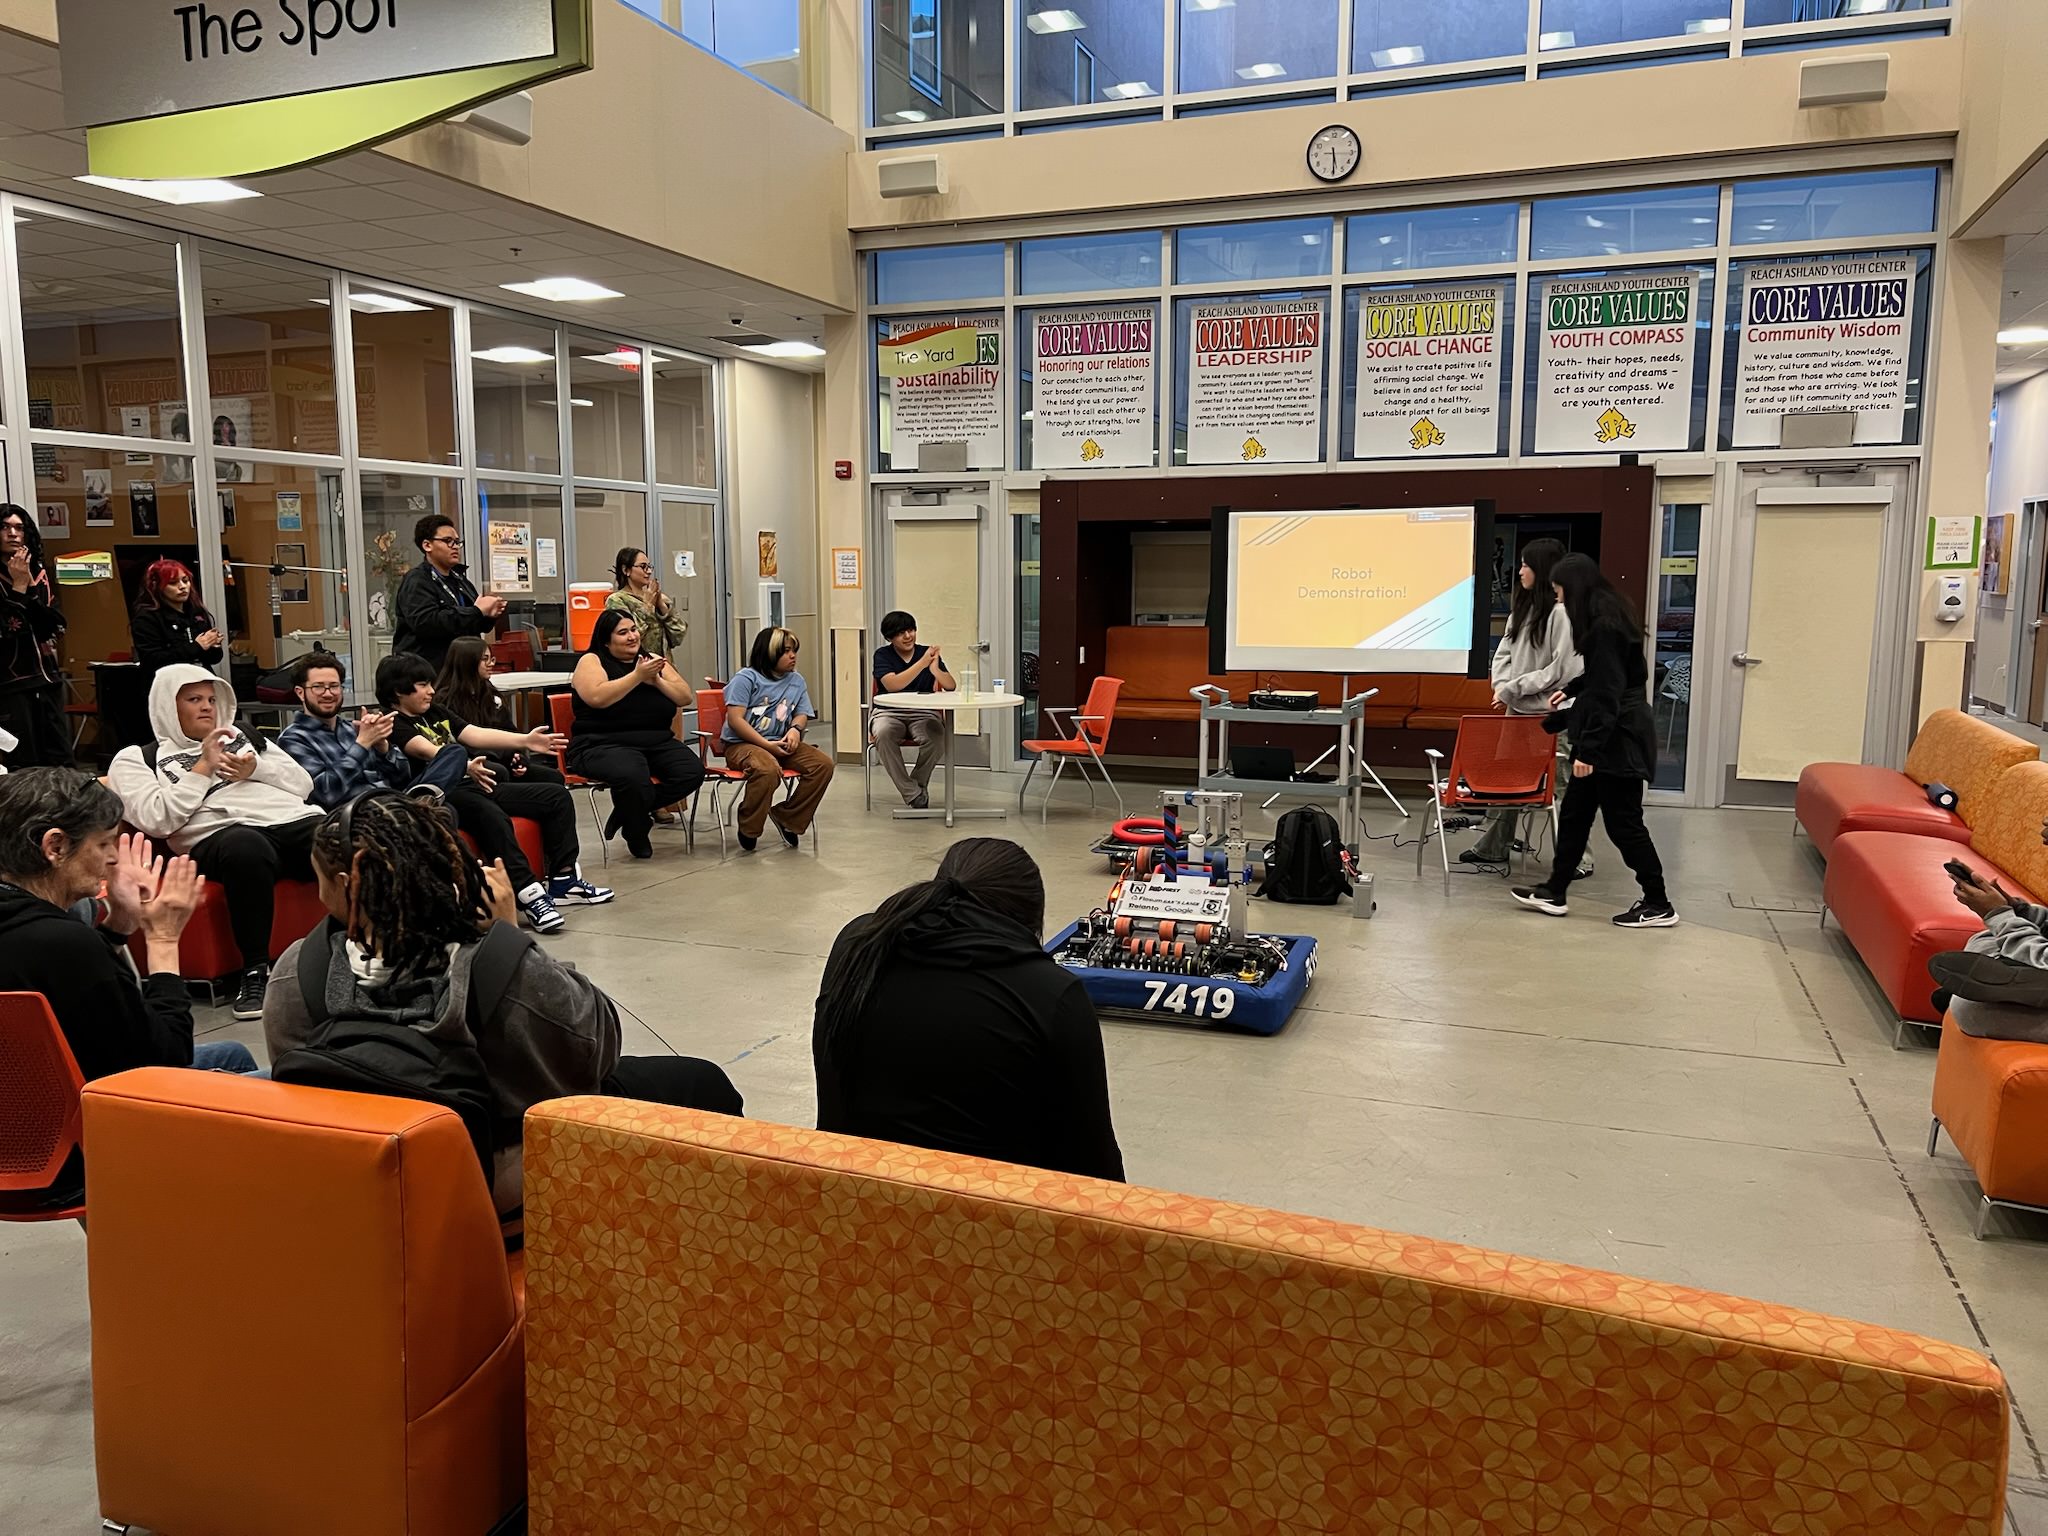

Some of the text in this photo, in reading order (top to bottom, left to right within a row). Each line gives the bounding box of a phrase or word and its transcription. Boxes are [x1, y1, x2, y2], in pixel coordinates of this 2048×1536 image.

[174, 3, 262, 61] The
[1751, 261, 1905, 280] REACH ASHLAND YOUTH CENTER
[1552, 277, 1689, 294] REACH ASHLAND YOUTH CENTER
[1368, 289, 1495, 304] REACH ASHLAND YOUTH CENTER
[1752, 281, 1902, 323] CORE VALUES
[1198, 303, 1317, 318] REACH ASHLAND YOUTH CENTER
[1550, 290, 1686, 327] CORE VALUES
[1039, 309, 1151, 324] REACH ASHLAND YOUTH CENTER
[1368, 302, 1493, 338] CORE VALUES
[1040, 321, 1148, 355] CORE VALUES
[1198, 315, 1314, 351] CORE VALUES
[1551, 328, 1684, 348] YOUTH COMPASS
[1748, 322, 1900, 342] Community Wisdom
[1367, 337, 1492, 358] SOCIAL CHANGE
[895, 351, 919, 364] The
[924, 348, 954, 362] Yard
[1198, 350, 1312, 367] LEADERSHIP
[1548, 353, 1684, 367] Youth- their hopes, needs,
[1040, 357, 1150, 373] Honoring our relations
[1445, 362, 1475, 371] positive
[897, 367, 999, 388] Sustainability
[1374, 376, 1410, 384] affirming
[1412, 374, 1434, 382] social
[1555, 368, 1667, 380] creativity and dreams
[1870, 369, 1899, 377] before
[1446, 384, 1458, 392] for
[1554, 385, 1570, 394] act
[1608, 384, 1653, 394] compass.
[1657, 381, 1674, 390] We
[1384, 399, 1411, 407] change
[1582, 398, 1610, 408] youth
[1614, 396, 1664, 405] centered.
[1807, 393, 1851, 401] community
[1873, 391, 1897, 400] youth
[1363, 409, 1406, 417] sustainable
[1409, 408, 1434, 416] planet
[1465, 407, 1490, 415] beings
[1332, 567, 1373, 580] Robot
[1298, 586, 1407, 599] Demonstration!
[1165, 906, 1193, 914] Google
[1144, 981, 1234, 1019] 7419
